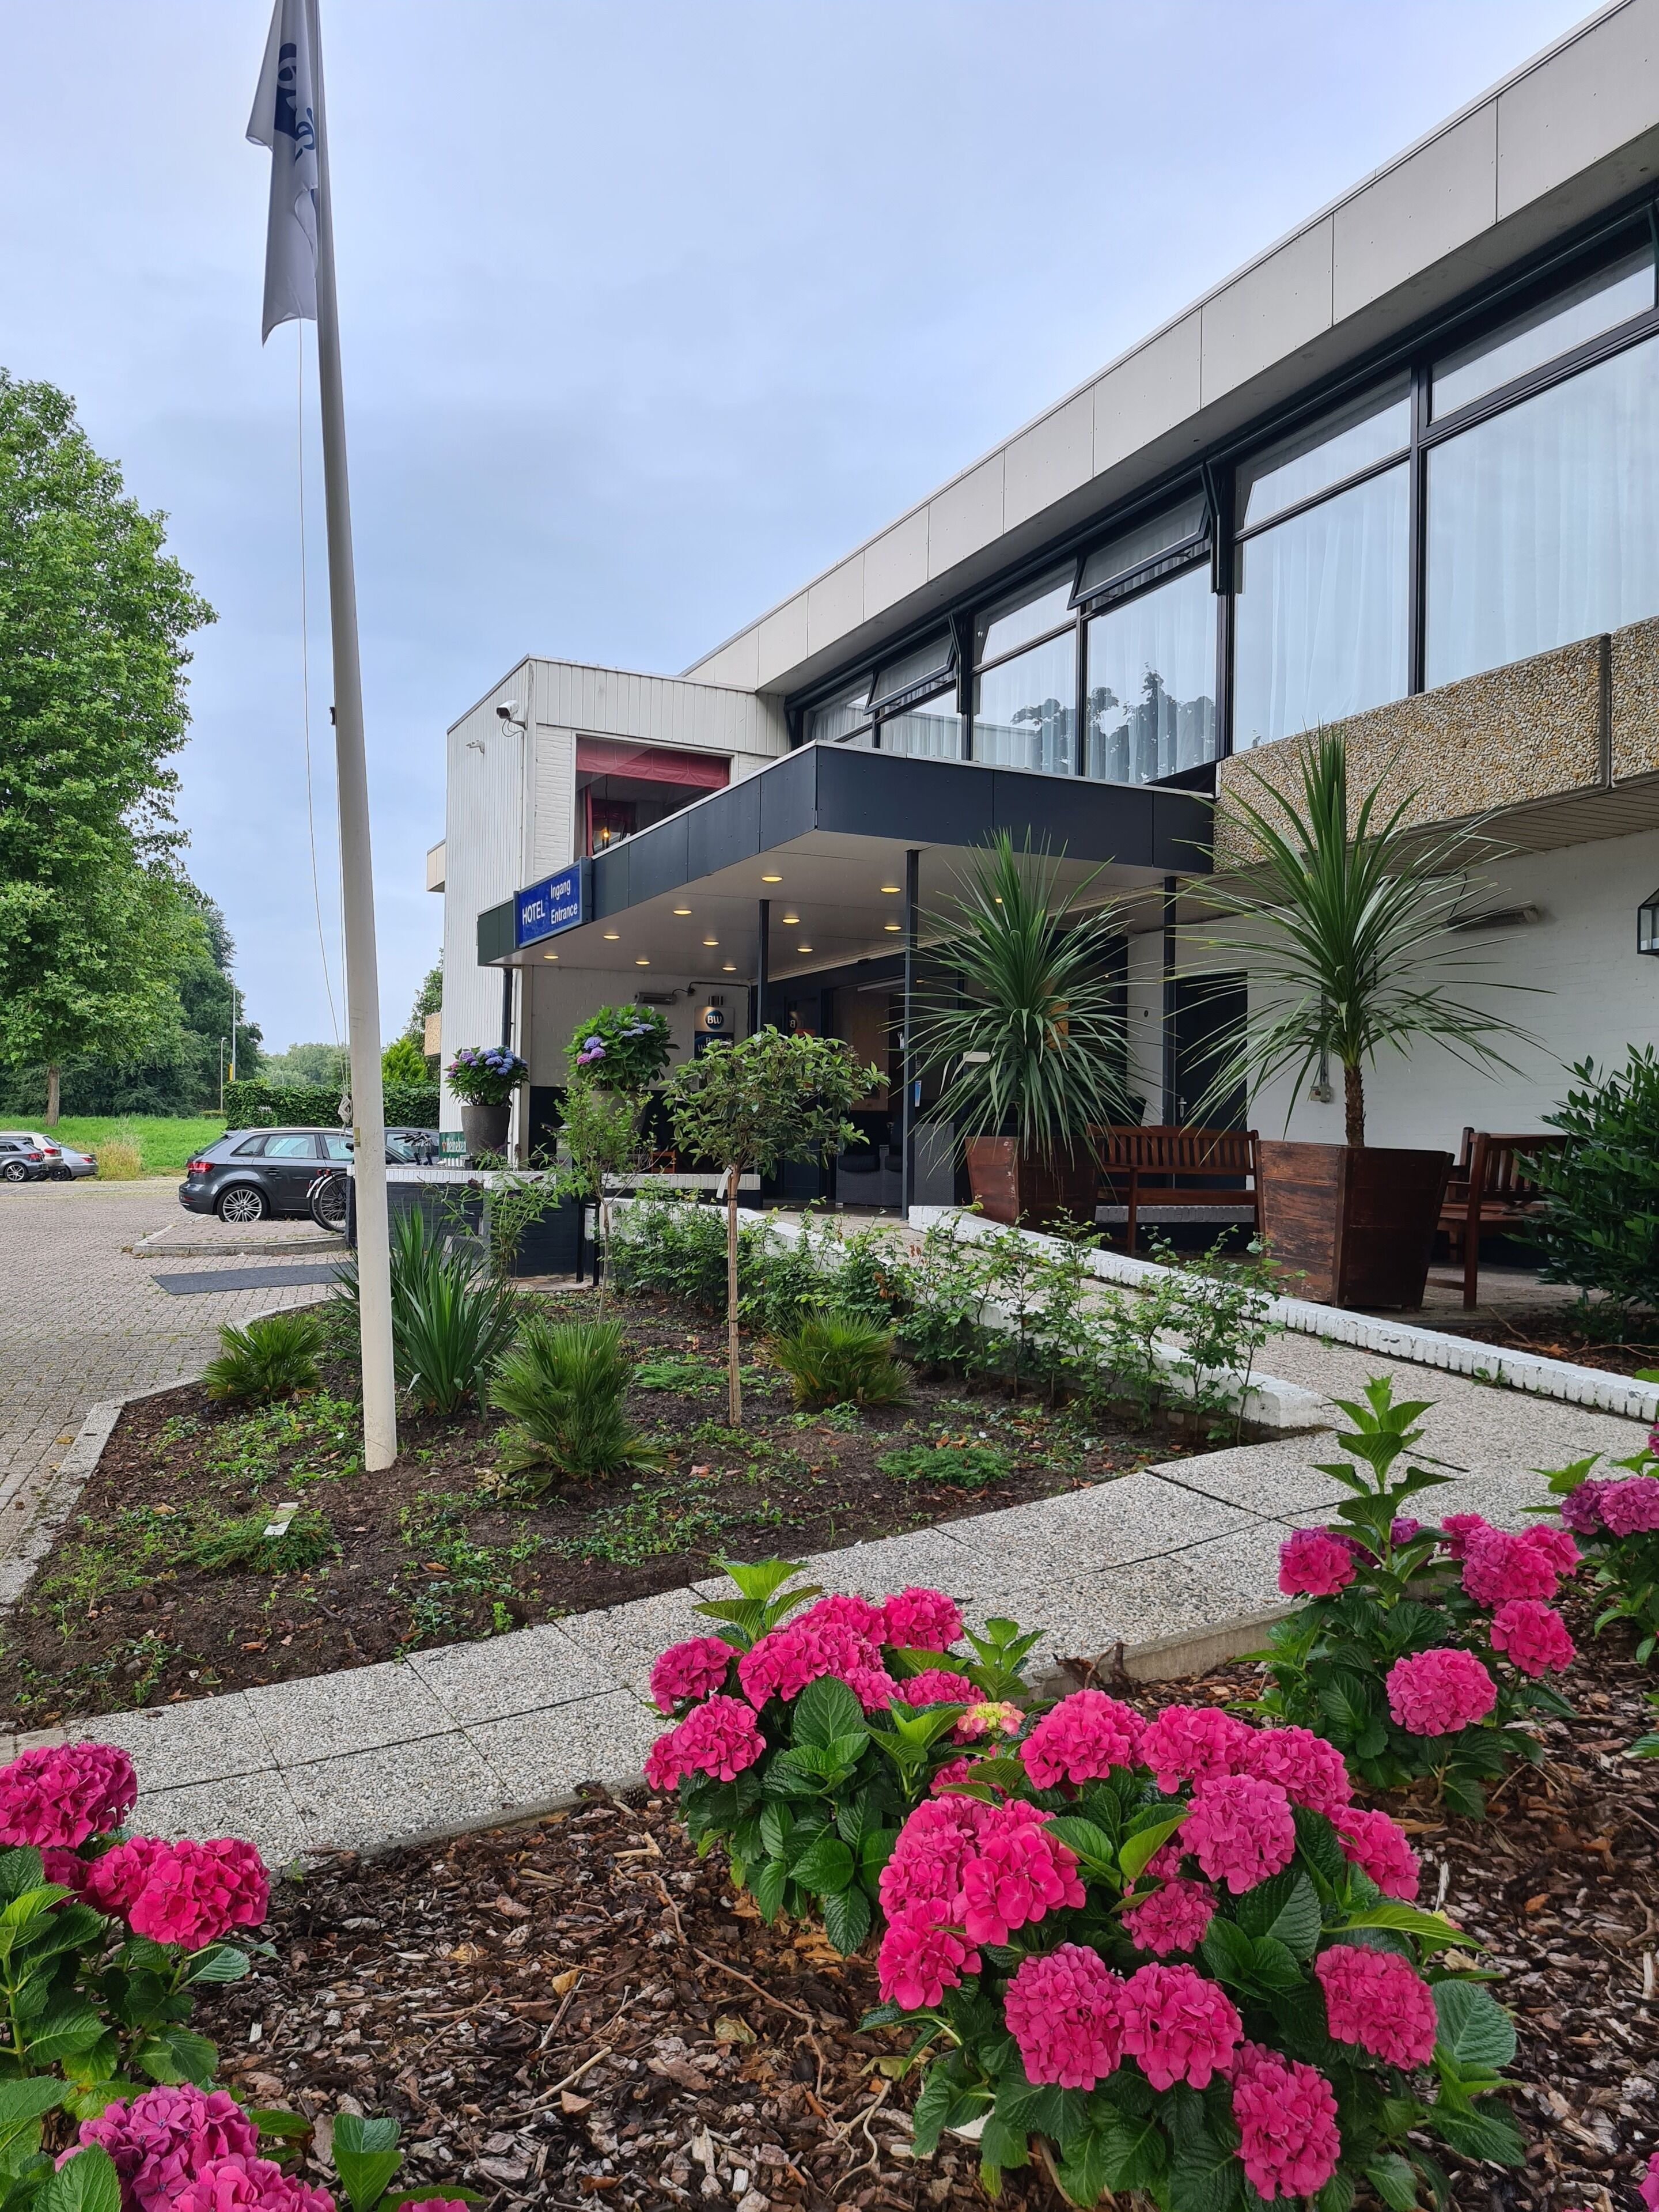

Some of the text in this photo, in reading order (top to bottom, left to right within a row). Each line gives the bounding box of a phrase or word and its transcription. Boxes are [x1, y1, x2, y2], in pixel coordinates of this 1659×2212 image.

[551, 880, 570, 900] Ingang
[522, 899, 546, 925] HOTEL
[551, 903, 578, 925] Entrance
[707, 1016, 722, 1024] BW
[446, 1137, 467, 1153] Heineken
